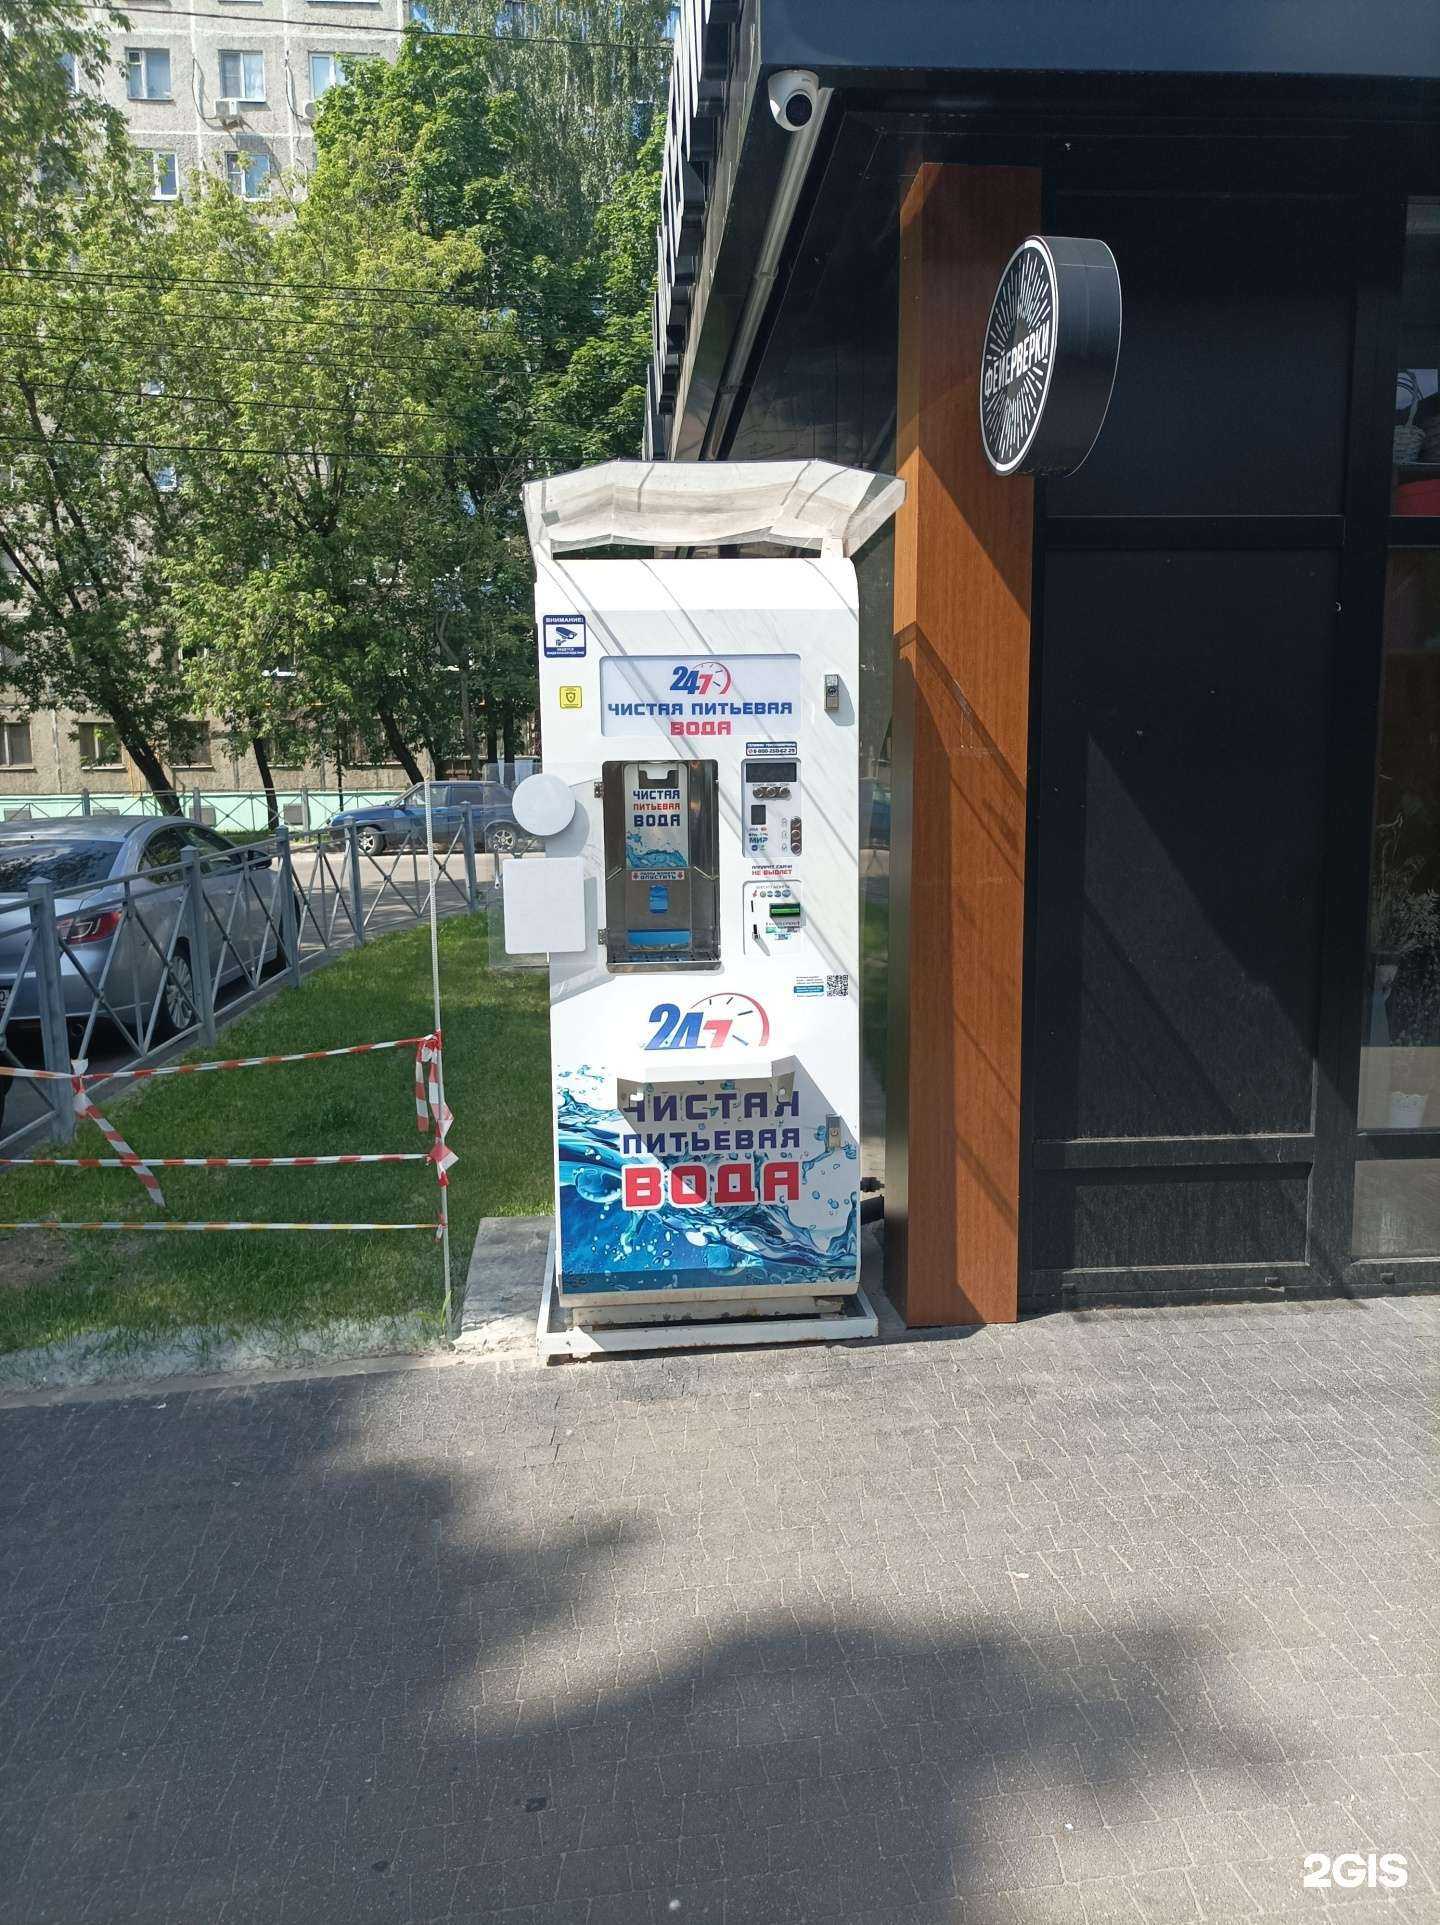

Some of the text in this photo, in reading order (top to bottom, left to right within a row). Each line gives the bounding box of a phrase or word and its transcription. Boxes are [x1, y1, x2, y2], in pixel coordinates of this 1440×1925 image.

[984, 320, 1050, 398] ФЕЙЕРВЕРКИ
[669, 666, 714, 695] 247
[608, 702, 793, 716] ЧИСТАЯ ПИТЬЕВАЯ
[670, 721, 732, 736] ВОДА
[633, 789, 680, 800] ЧИСТАЯ
[633, 802, 680, 811] ПИТЬЕВАЯ
[634, 813, 681, 827] ВОДА
[623, 1128, 800, 1155] ПИТЬЕВАЯ
[625, 1162, 800, 1207] ВОДА
